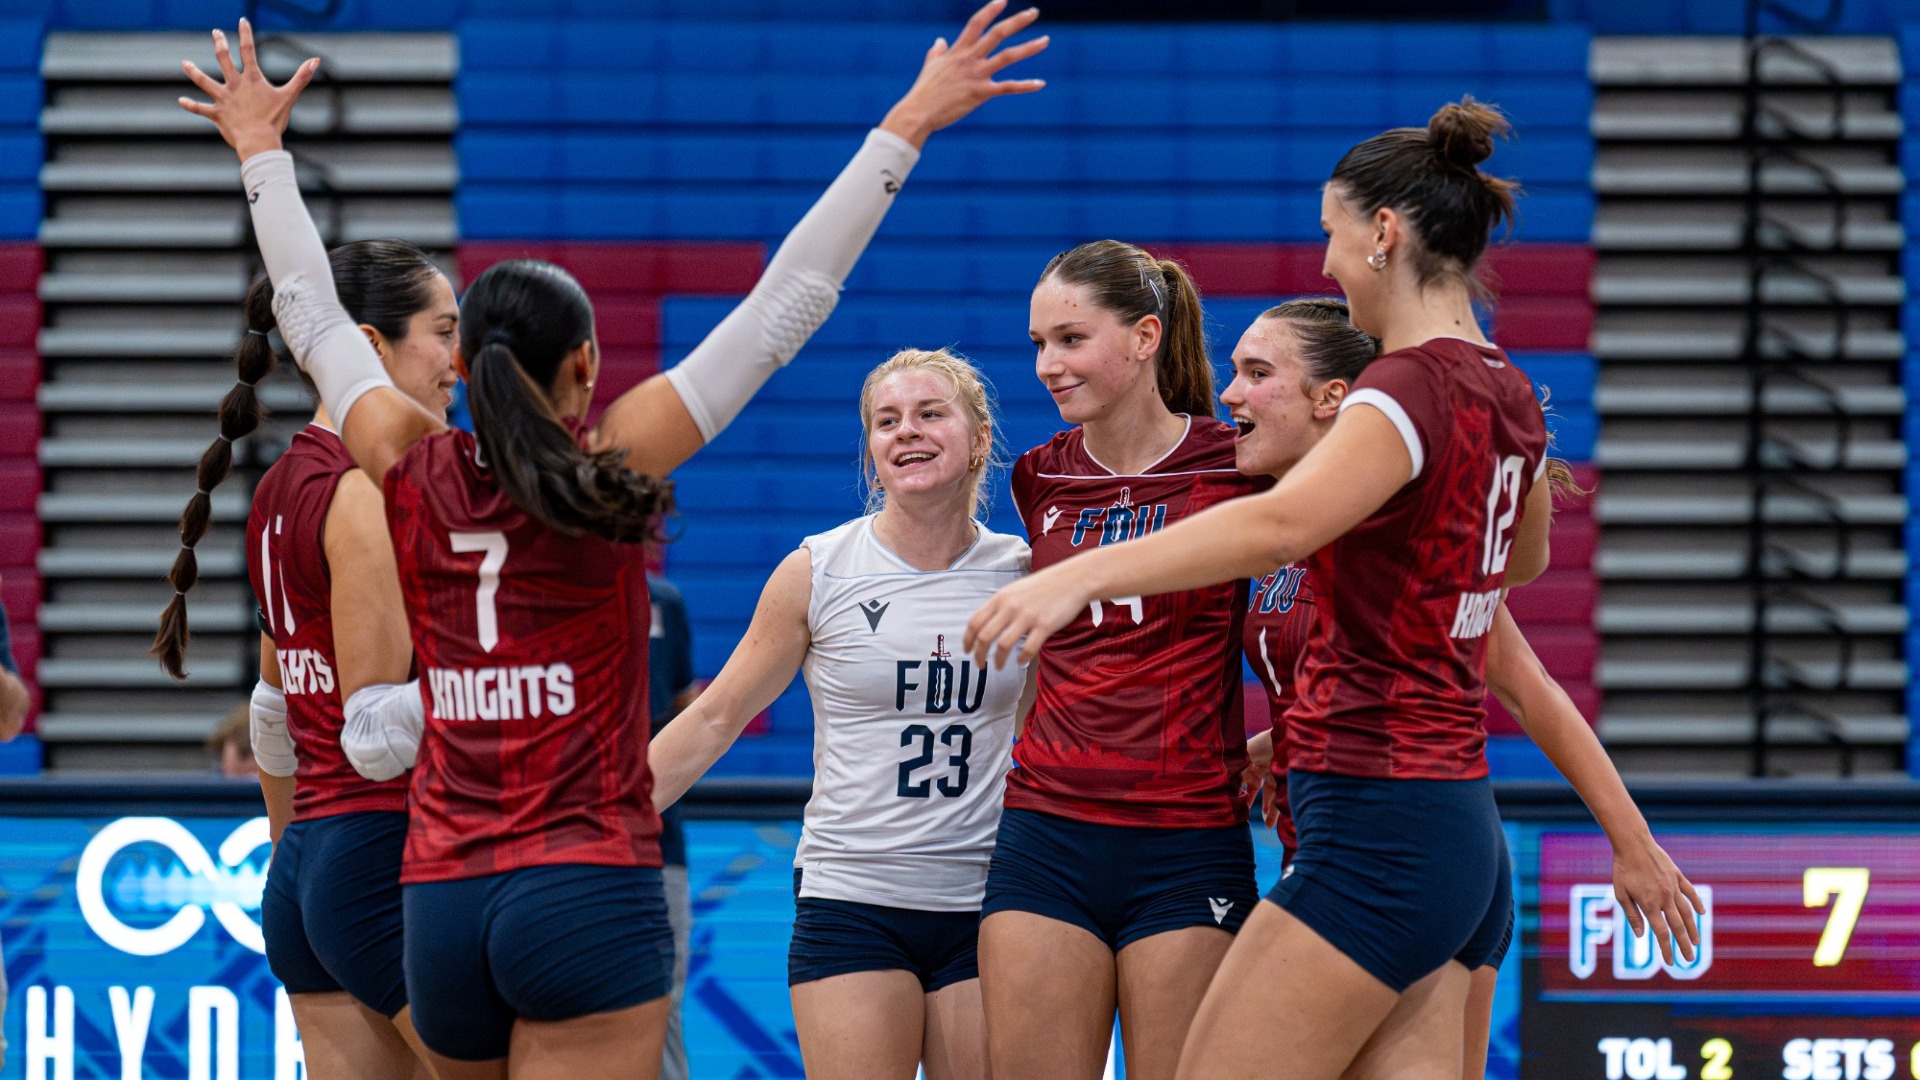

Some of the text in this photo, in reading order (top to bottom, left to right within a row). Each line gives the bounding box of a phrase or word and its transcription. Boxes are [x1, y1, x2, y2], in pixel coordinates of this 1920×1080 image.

[1070, 504, 1167, 547] FDU
[1482, 454, 1526, 576] 12
[449, 531, 509, 653] 7
[1248, 567, 1307, 613] FDU
[896, 659, 988, 714] FDU
[1259, 625, 1282, 696] 1
[427, 662, 575, 721] KNIGHTS
[897, 724, 972, 798] 23
[1803, 867, 1870, 967] 7
[1597, 1037, 1733, 1080] TOL 2
[1782, 1038, 1896, 1080] SETS
